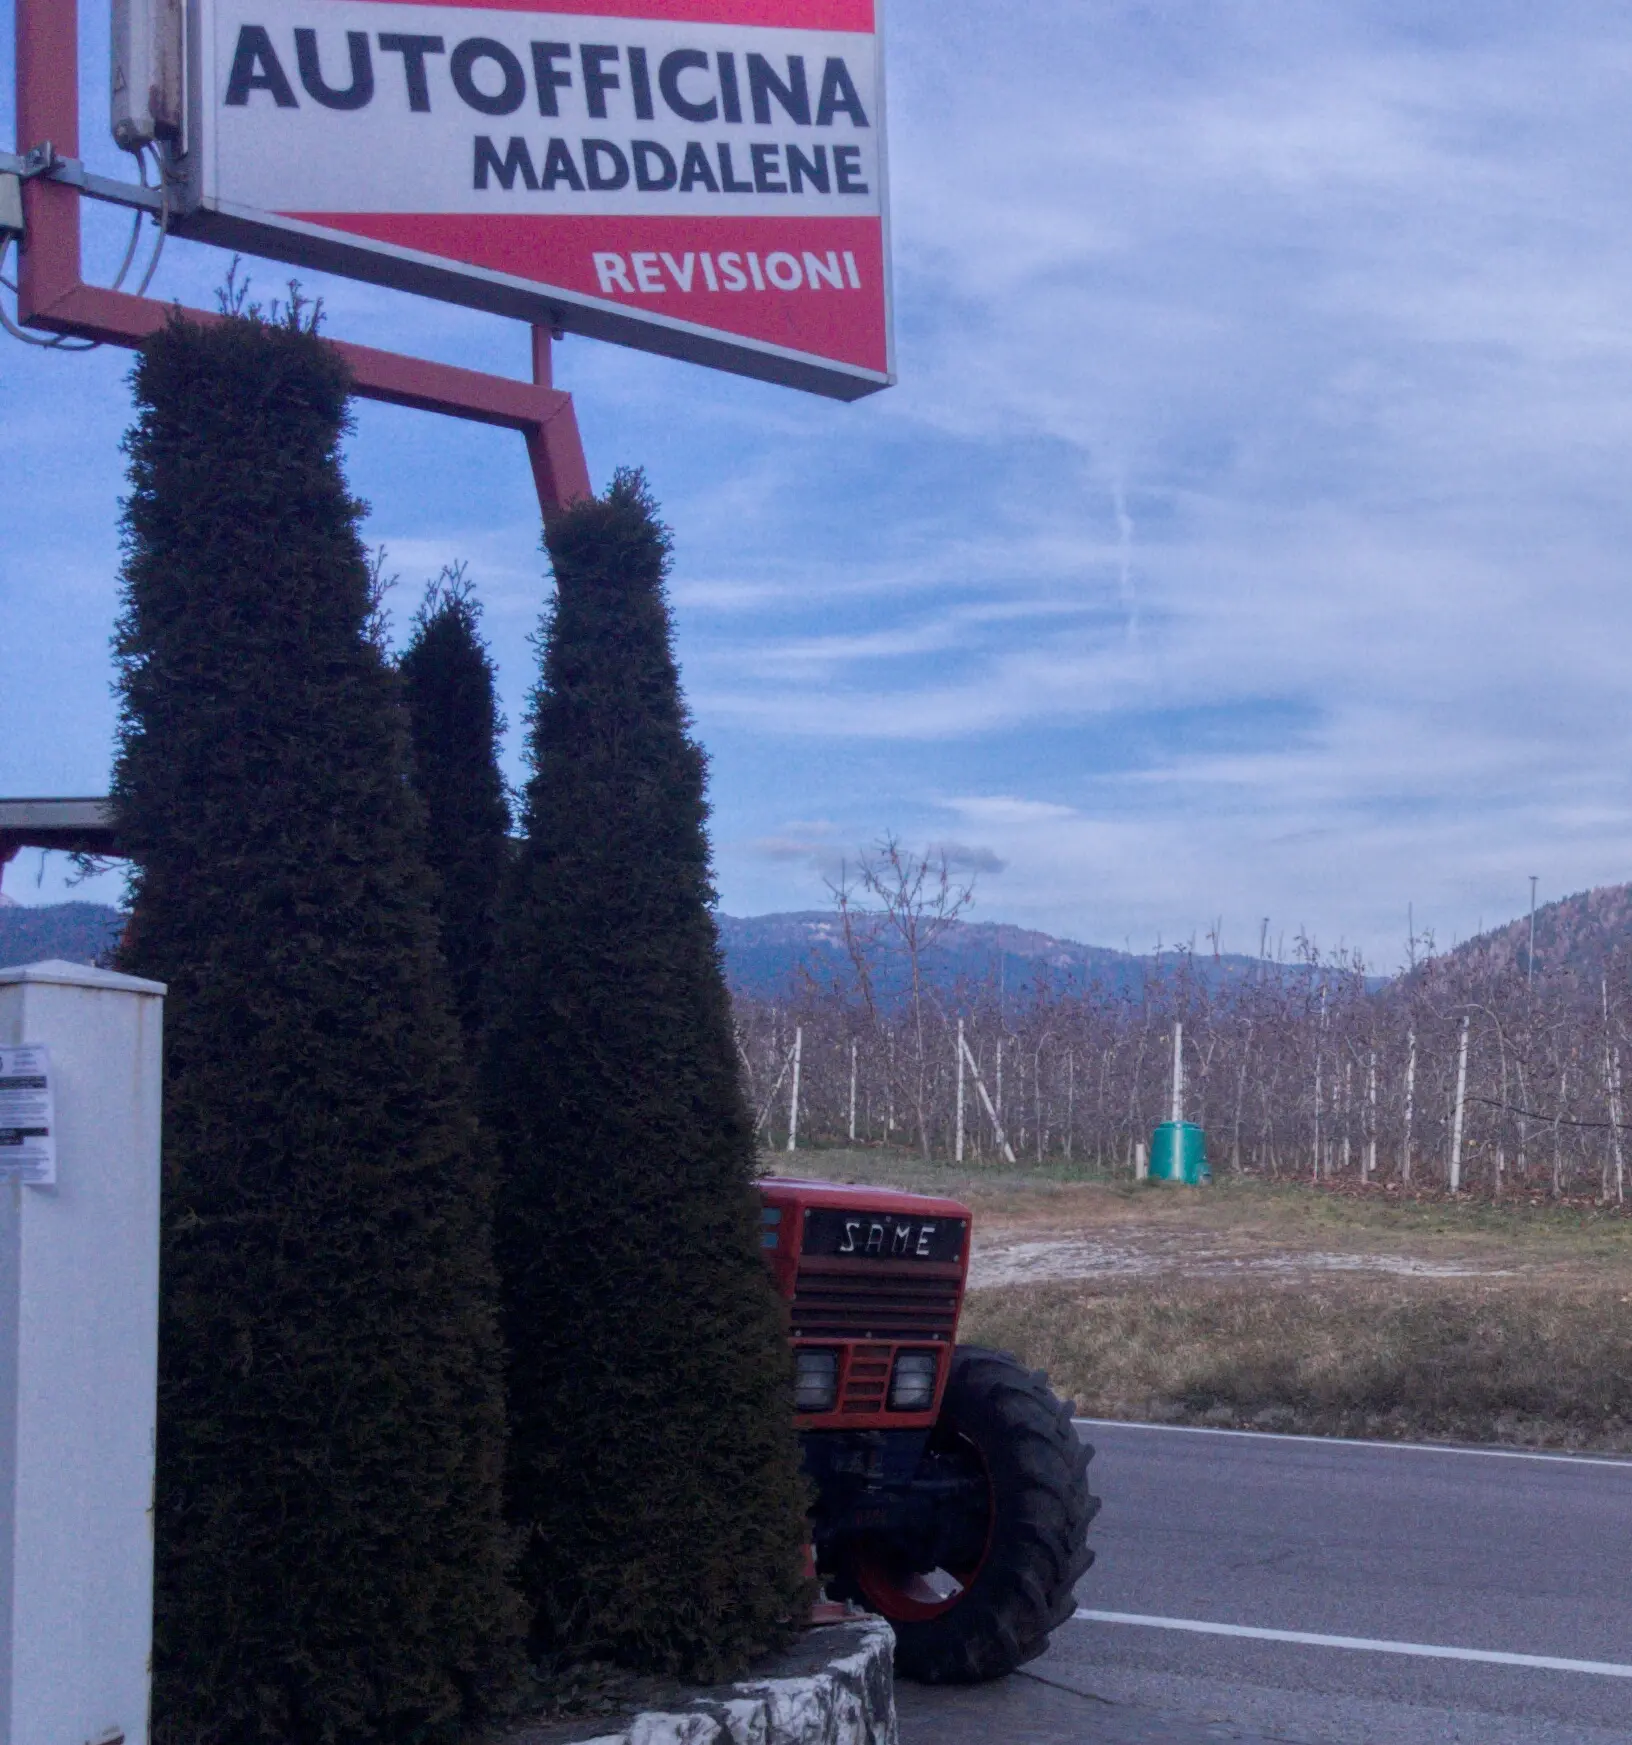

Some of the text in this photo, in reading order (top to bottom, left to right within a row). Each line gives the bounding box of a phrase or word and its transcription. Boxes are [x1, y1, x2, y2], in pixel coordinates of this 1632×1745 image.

[224, 24, 870, 128] AUTOFFICINA
[473, 135, 869, 195] MADDALENE
[593, 251, 861, 293] REVISIONI
[840, 1222, 935, 1256] SAME
